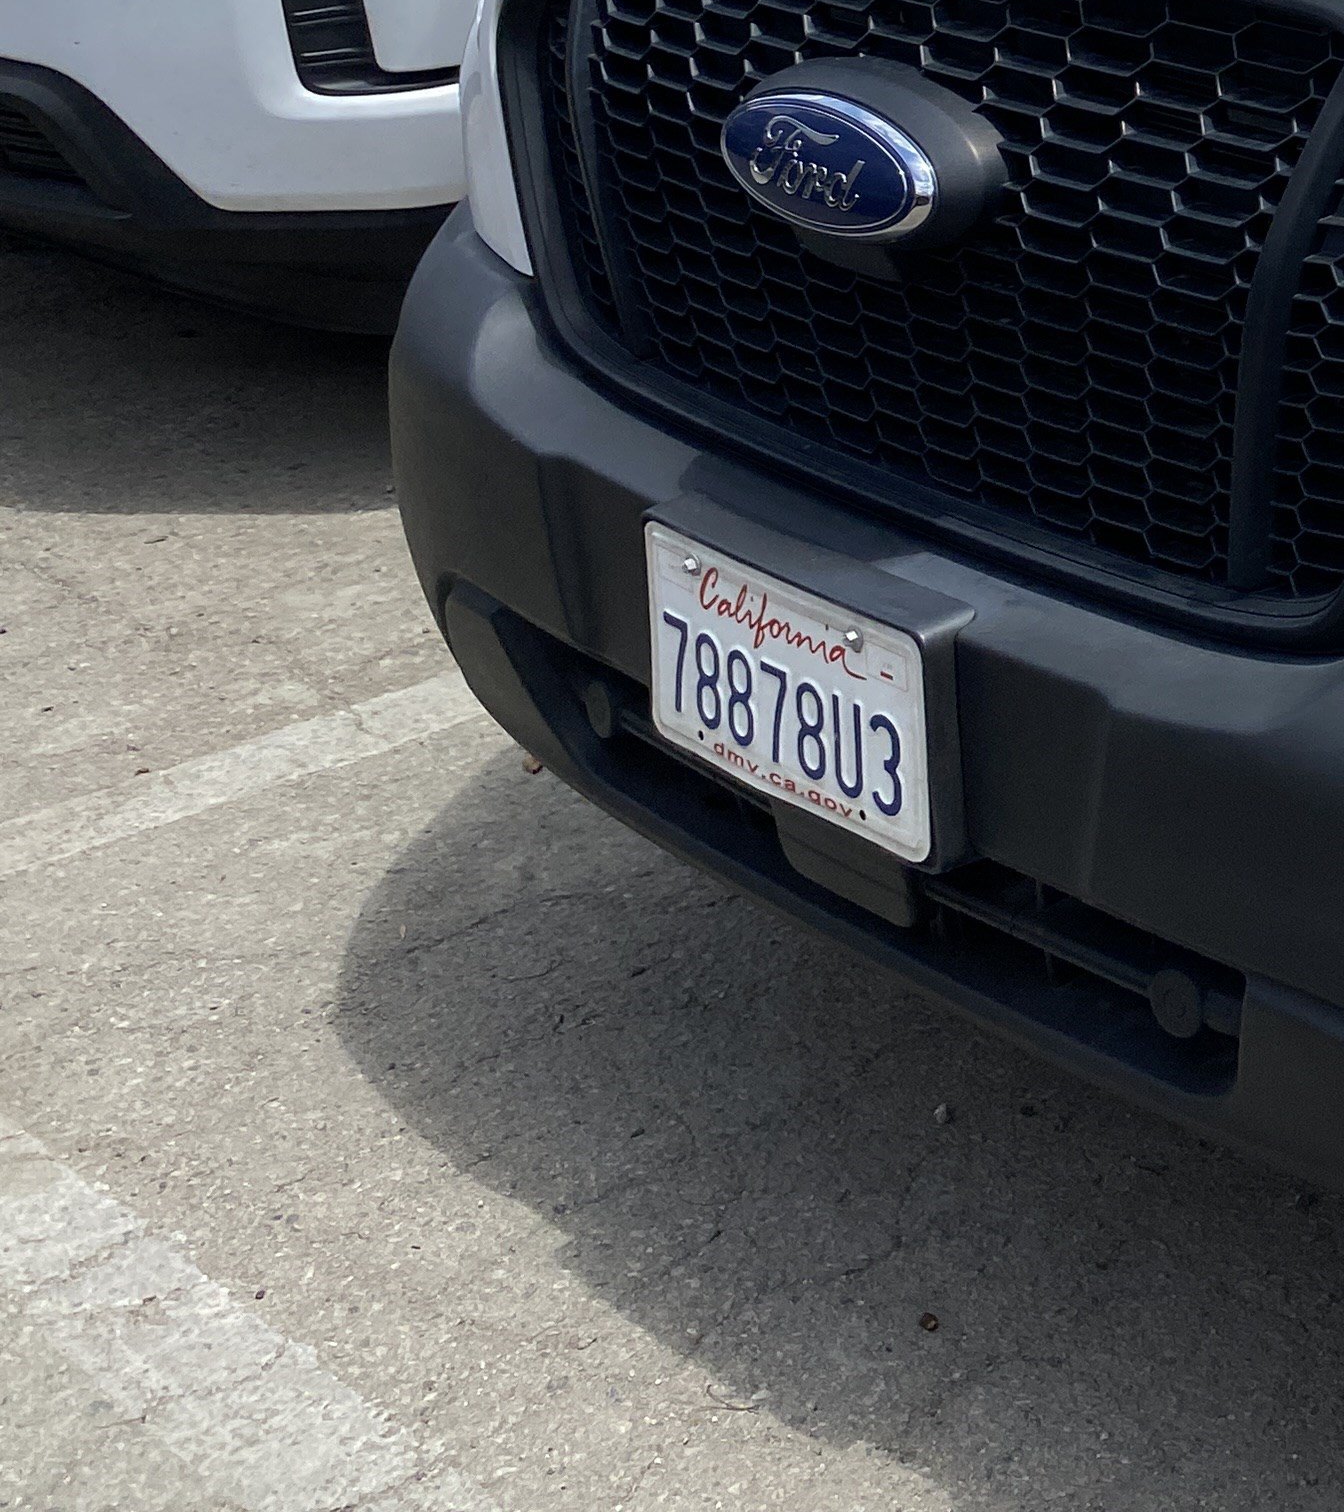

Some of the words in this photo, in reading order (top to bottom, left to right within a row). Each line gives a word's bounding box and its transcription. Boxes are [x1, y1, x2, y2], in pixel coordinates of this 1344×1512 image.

[749, 114, 867, 211] Ford
[699, 567, 867, 681] California
[662, 610, 903, 818] 78878U3
[713, 740, 854, 821] dmv.ca.gov
